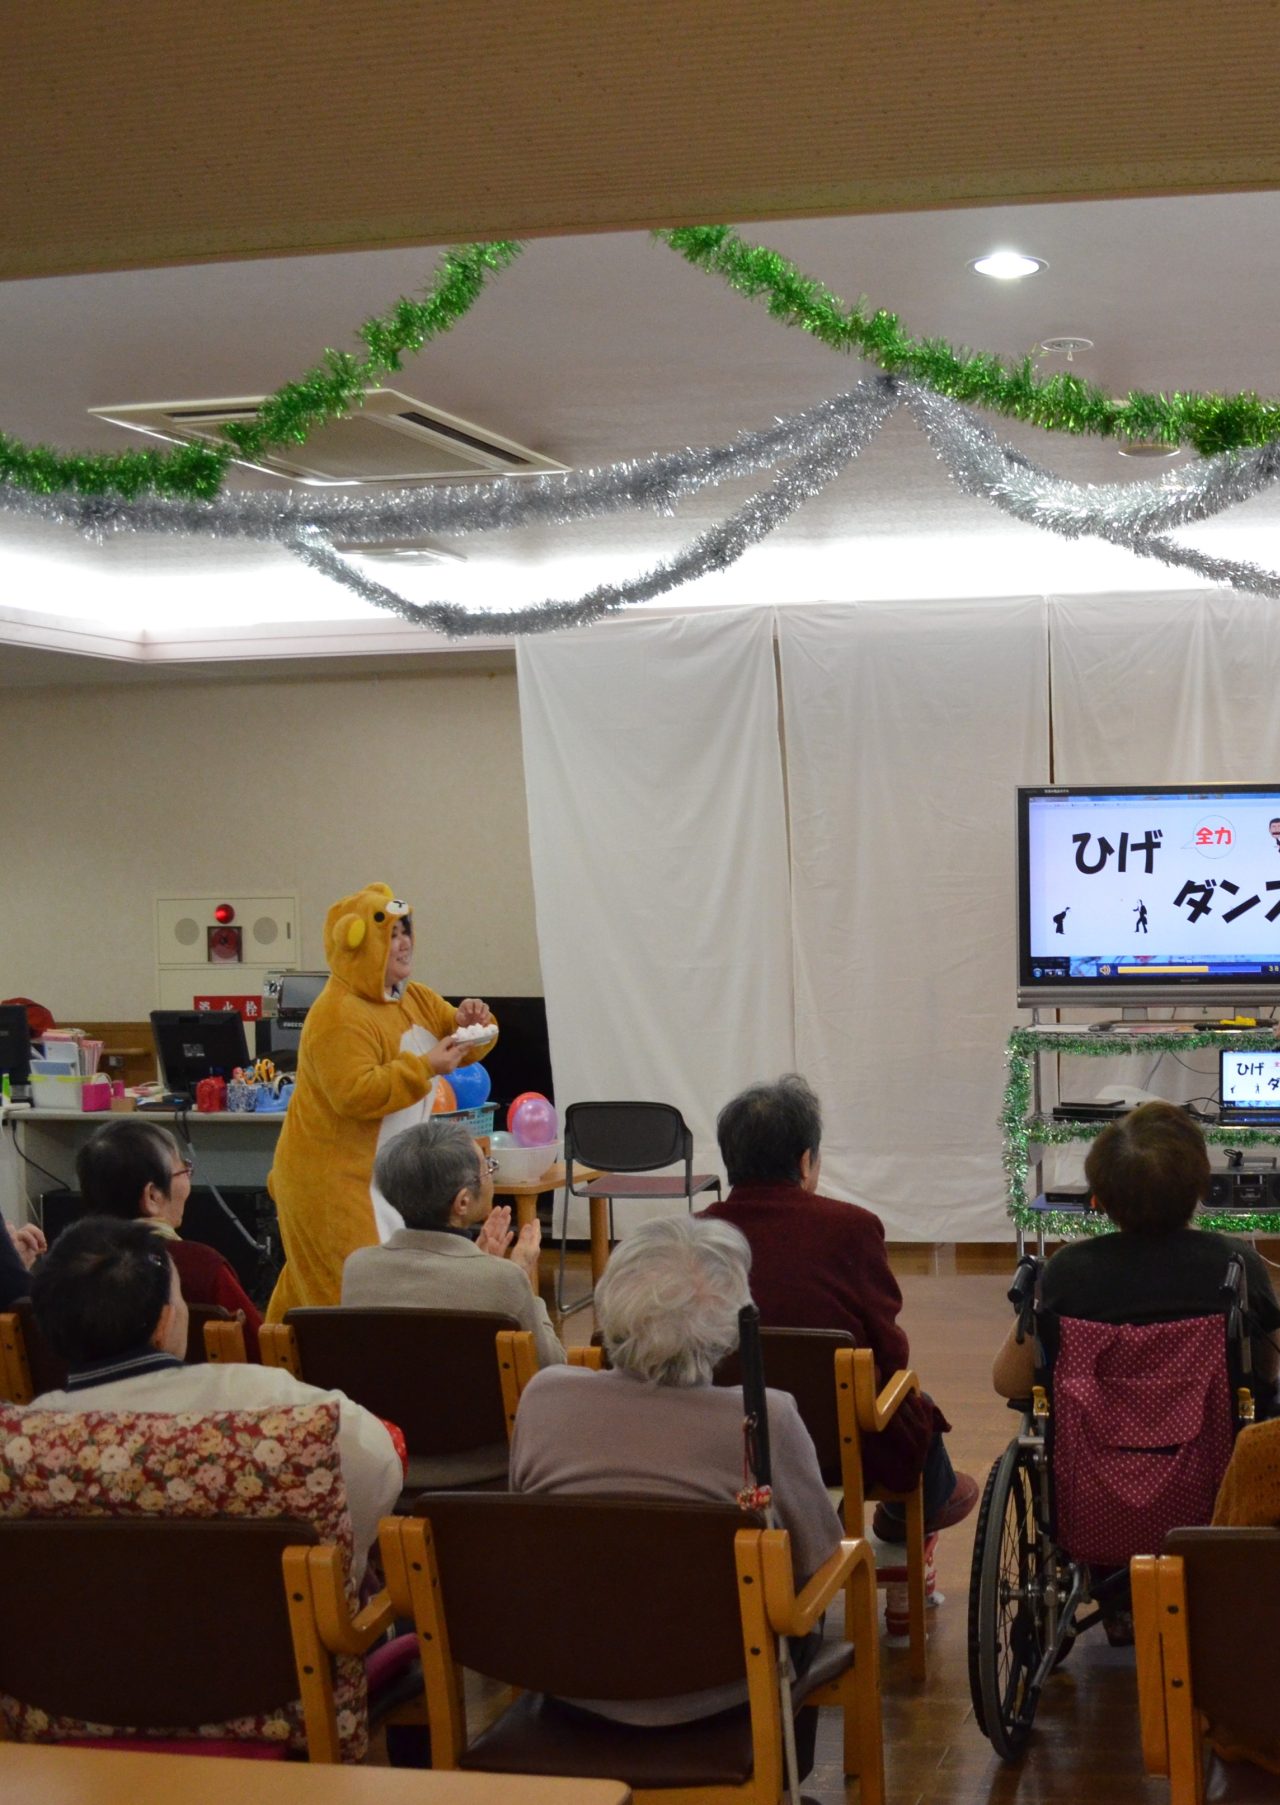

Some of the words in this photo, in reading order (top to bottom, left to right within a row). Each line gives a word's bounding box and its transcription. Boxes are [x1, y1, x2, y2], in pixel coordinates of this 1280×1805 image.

[1195, 827, 1232, 845] 全力
[1072, 829, 1163, 874] ひげ
[1236, 1062, 1264, 1076] ひげ
